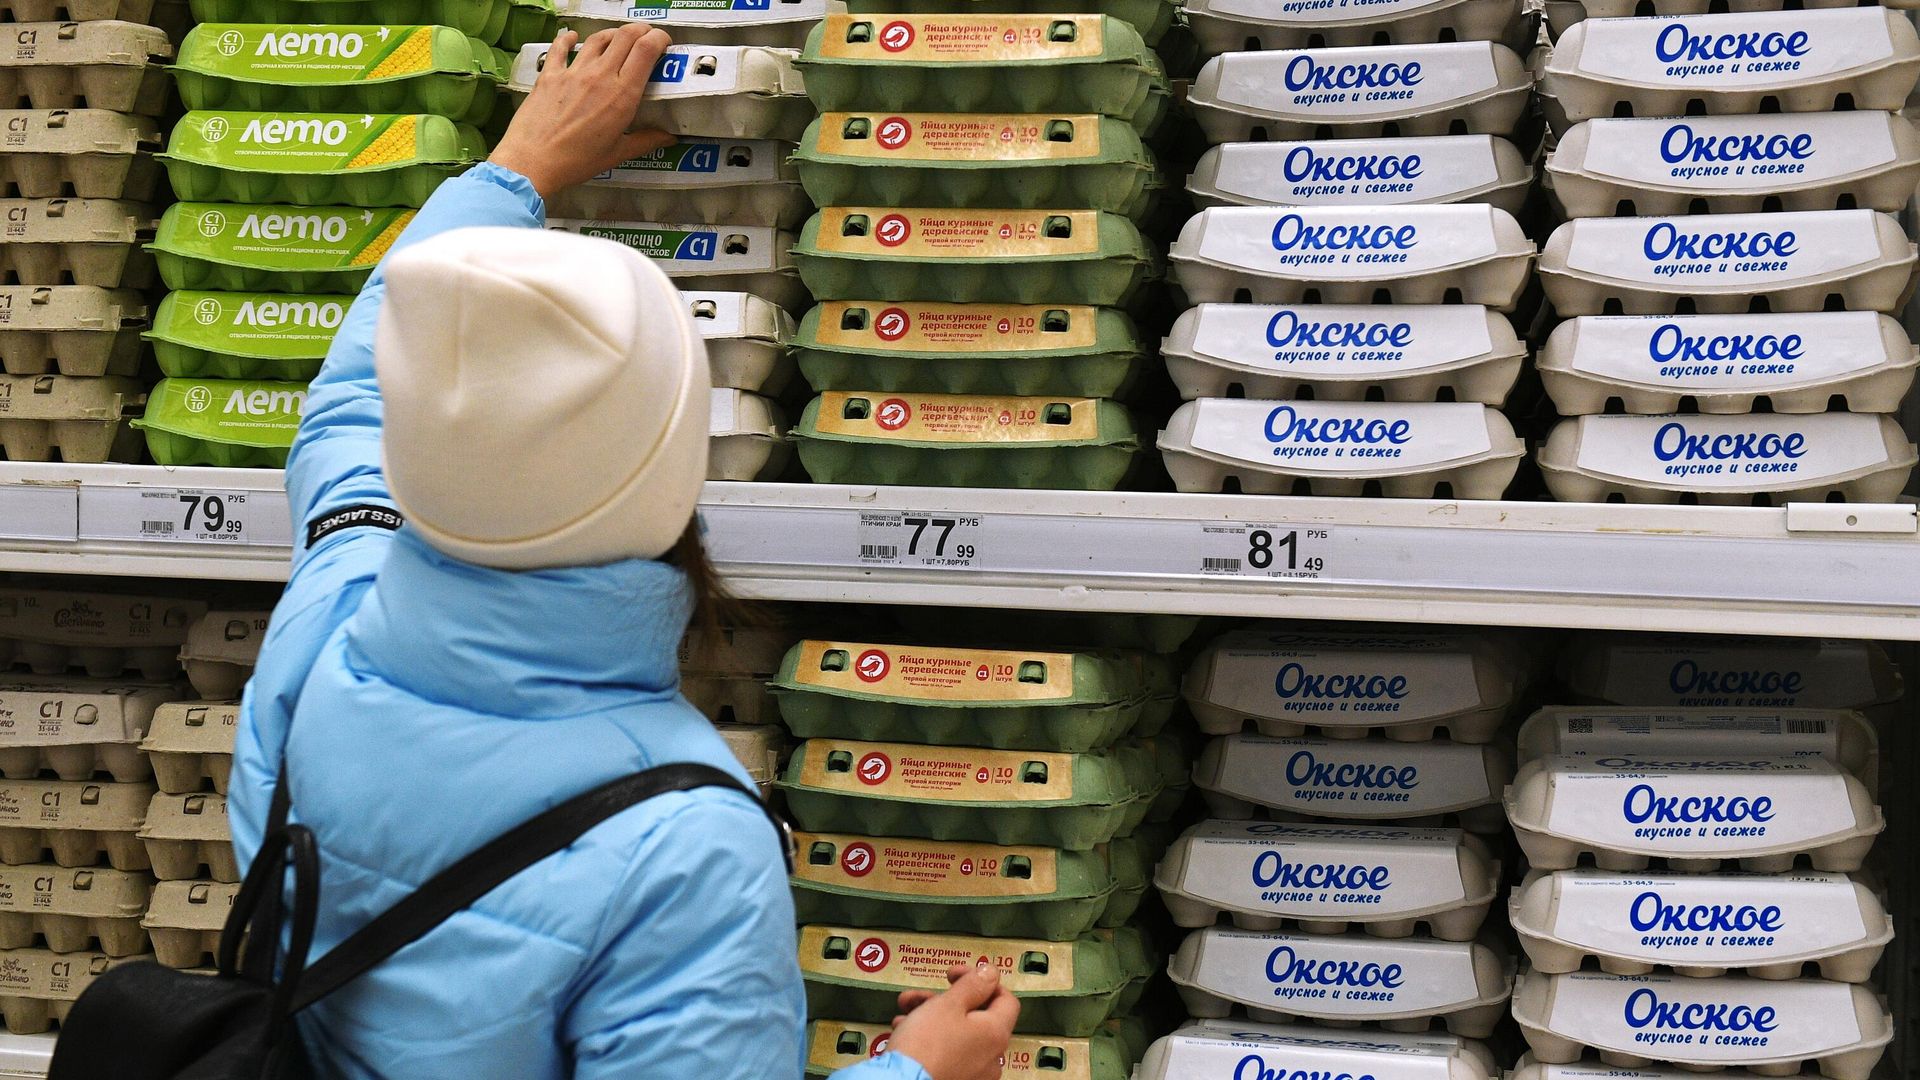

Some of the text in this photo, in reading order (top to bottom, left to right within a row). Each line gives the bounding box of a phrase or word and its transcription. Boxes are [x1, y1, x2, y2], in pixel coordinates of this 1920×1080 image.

[633, 9, 663, 18] БЕЛОЕ
[924, 24, 949, 34] Яйца
[17, 30, 37, 45] С1
[1655, 23, 1811, 64] Окское
[662, 60, 680, 79] С1
[1284, 54, 1424, 93] Окское
[1667, 62, 1800, 76] вкусное и свежее
[1295, 90, 1414, 104] вкусное и свежее
[8, 117, 28, 132] С1
[920, 121, 947, 131] Яйца
[1660, 124, 1814, 165] Окское
[692, 150, 711, 169] С1
[1284, 145, 1424, 183] Окское
[7, 207, 28, 222] С1
[920, 218, 993, 228] Яйца куриные
[922, 227, 989, 236] деревенские
[1271, 213, 1419, 252] Окское
[689, 238, 708, 257] С1
[1643, 222, 1798, 261] Окское
[918, 312, 992, 322] Яйца куриные
[1018, 317, 1035, 328] 10
[921, 322, 987, 330] деревенские
[1265, 309, 1413, 348] Окское
[1649, 324, 1804, 363] Окское
[920, 403, 945, 412] Яйца
[1019, 410, 1036, 419] 10
[1263, 405, 1412, 445] Окское
[1653, 423, 1806, 463] Окское
[1274, 448, 1401, 458] вкусное и свежее
[1665, 463, 1798, 476] вкусное и свежее
[228, 495, 246, 503] РУБ
[180, 496, 225, 532] 79
[226, 520, 242, 533] 99
[959, 518, 979, 527] РУБ
[904, 518, 956, 557] 77
[1307, 530, 1328, 539] РУБ
[957, 545, 975, 559] 99
[1248, 530, 1297, 570] 81
[1304, 557, 1324, 571] 49
[899, 655, 971, 667] Яйца куриные
[901, 665, 966, 676] деревенские
[996, 665, 1013, 676] 10
[1275, 662, 1409, 700] Окское
[39, 701, 63, 718] С1
[1284, 700, 1405, 713] вкусное и свежее
[900, 757, 971, 769] Яйца куриные
[1285, 750, 1420, 790] Окское
[902, 768, 966, 778] деревенские
[996, 767, 1013, 778] 10
[41, 792, 60, 806] С1
[1623, 783, 1775, 825] Окское
[1634, 826, 1766, 839] вкусное и свежее
[884, 848, 956, 860] Яйца куриные
[886, 859, 951, 869] деревенские
[980, 859, 997, 869] 10
[1252, 850, 1391, 892] Окское
[34, 877, 53, 892] С1
[1261, 891, 1382, 904] вкусное и свежее
[1629, 891, 1783, 933] Окское
[1641, 936, 1774, 947] вкусное и свежее
[899, 944, 971, 957] Яйца куриные
[996, 956, 1013, 967] 10
[1265, 945, 1404, 990] Окское
[51, 962, 70, 977] С1
[1274, 988, 1394, 1002] вкусное и свежее
[1624, 988, 1779, 1033] Окское
[1635, 1033, 1769, 1046] вкусное и свежее
[1013, 1051, 1030, 1063] 10
